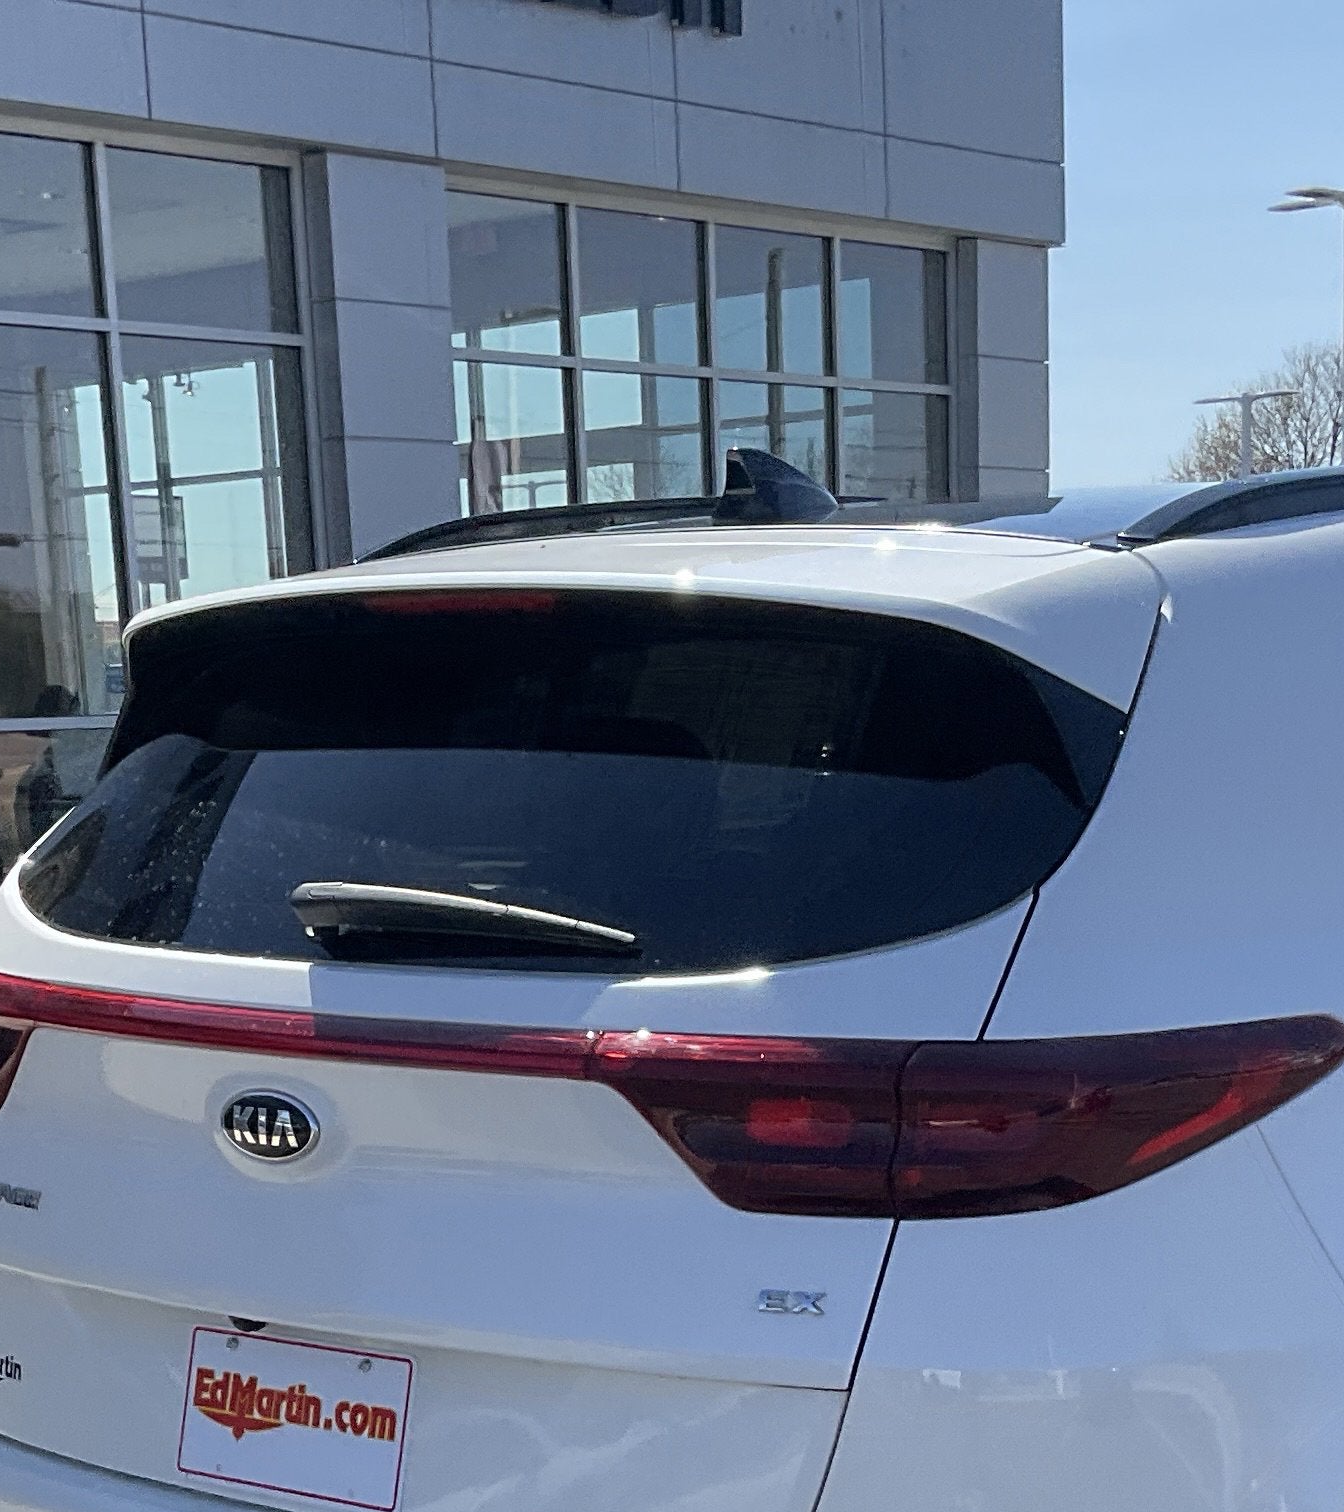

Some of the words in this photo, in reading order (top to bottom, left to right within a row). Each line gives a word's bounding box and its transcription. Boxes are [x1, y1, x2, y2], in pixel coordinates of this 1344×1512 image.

[233, 1105, 298, 1148] KIA
[758, 1288, 827, 1315] EX
[193, 1367, 397, 1442] EdMartin.com
